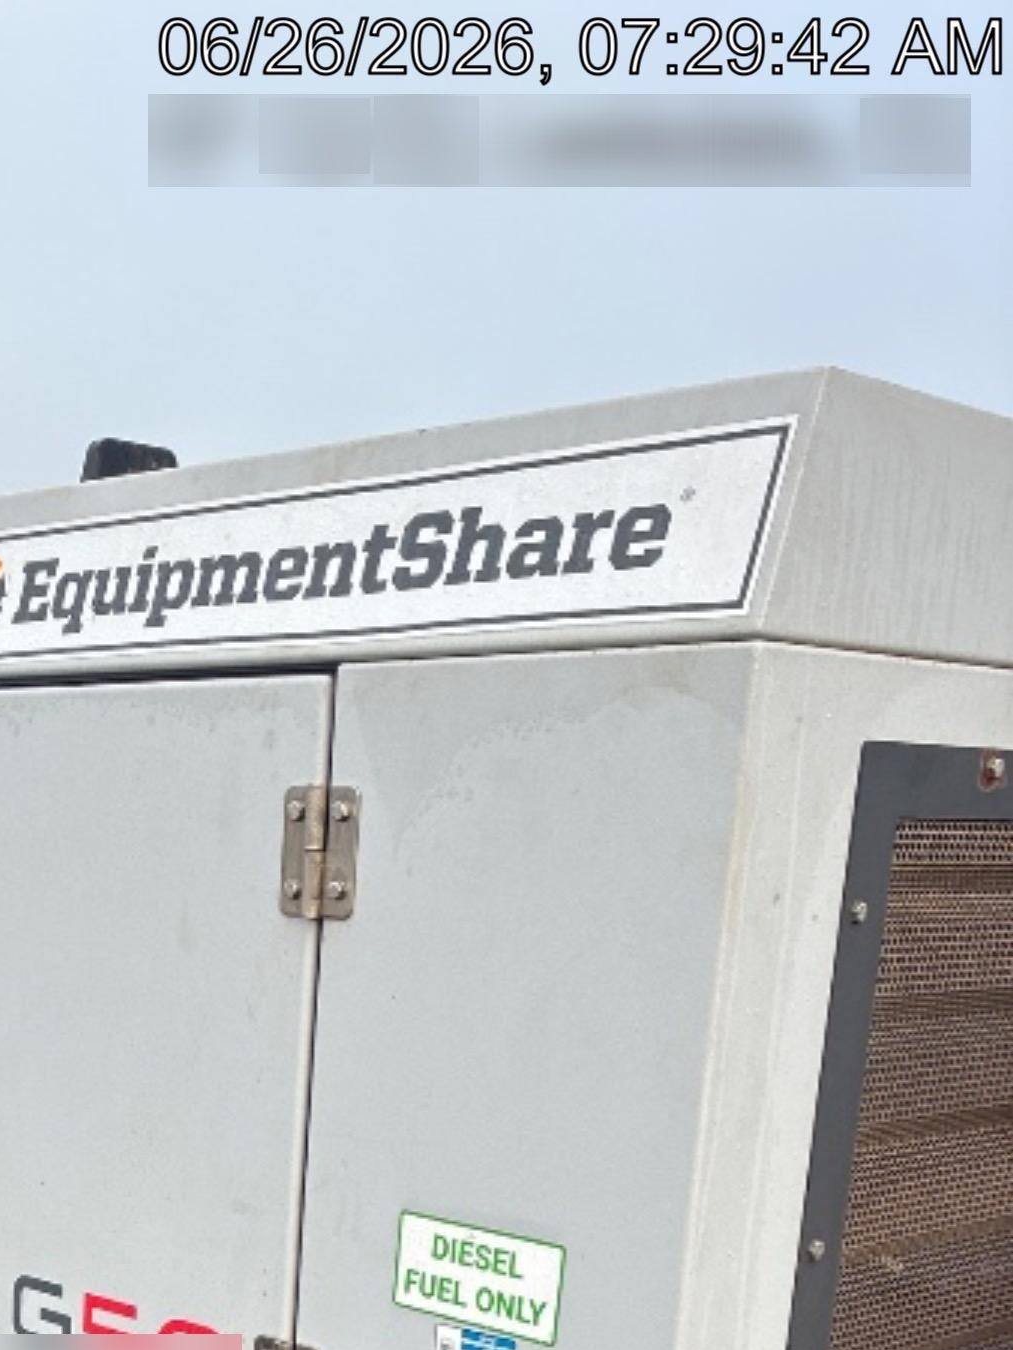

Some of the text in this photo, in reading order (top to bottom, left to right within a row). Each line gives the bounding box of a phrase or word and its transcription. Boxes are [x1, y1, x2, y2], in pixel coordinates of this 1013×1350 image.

[13, 503, 672, 634] EquipmentShare
[431, 1233, 523, 1279] DIESEL
[404, 1268, 547, 1327] FUEL ONLY
